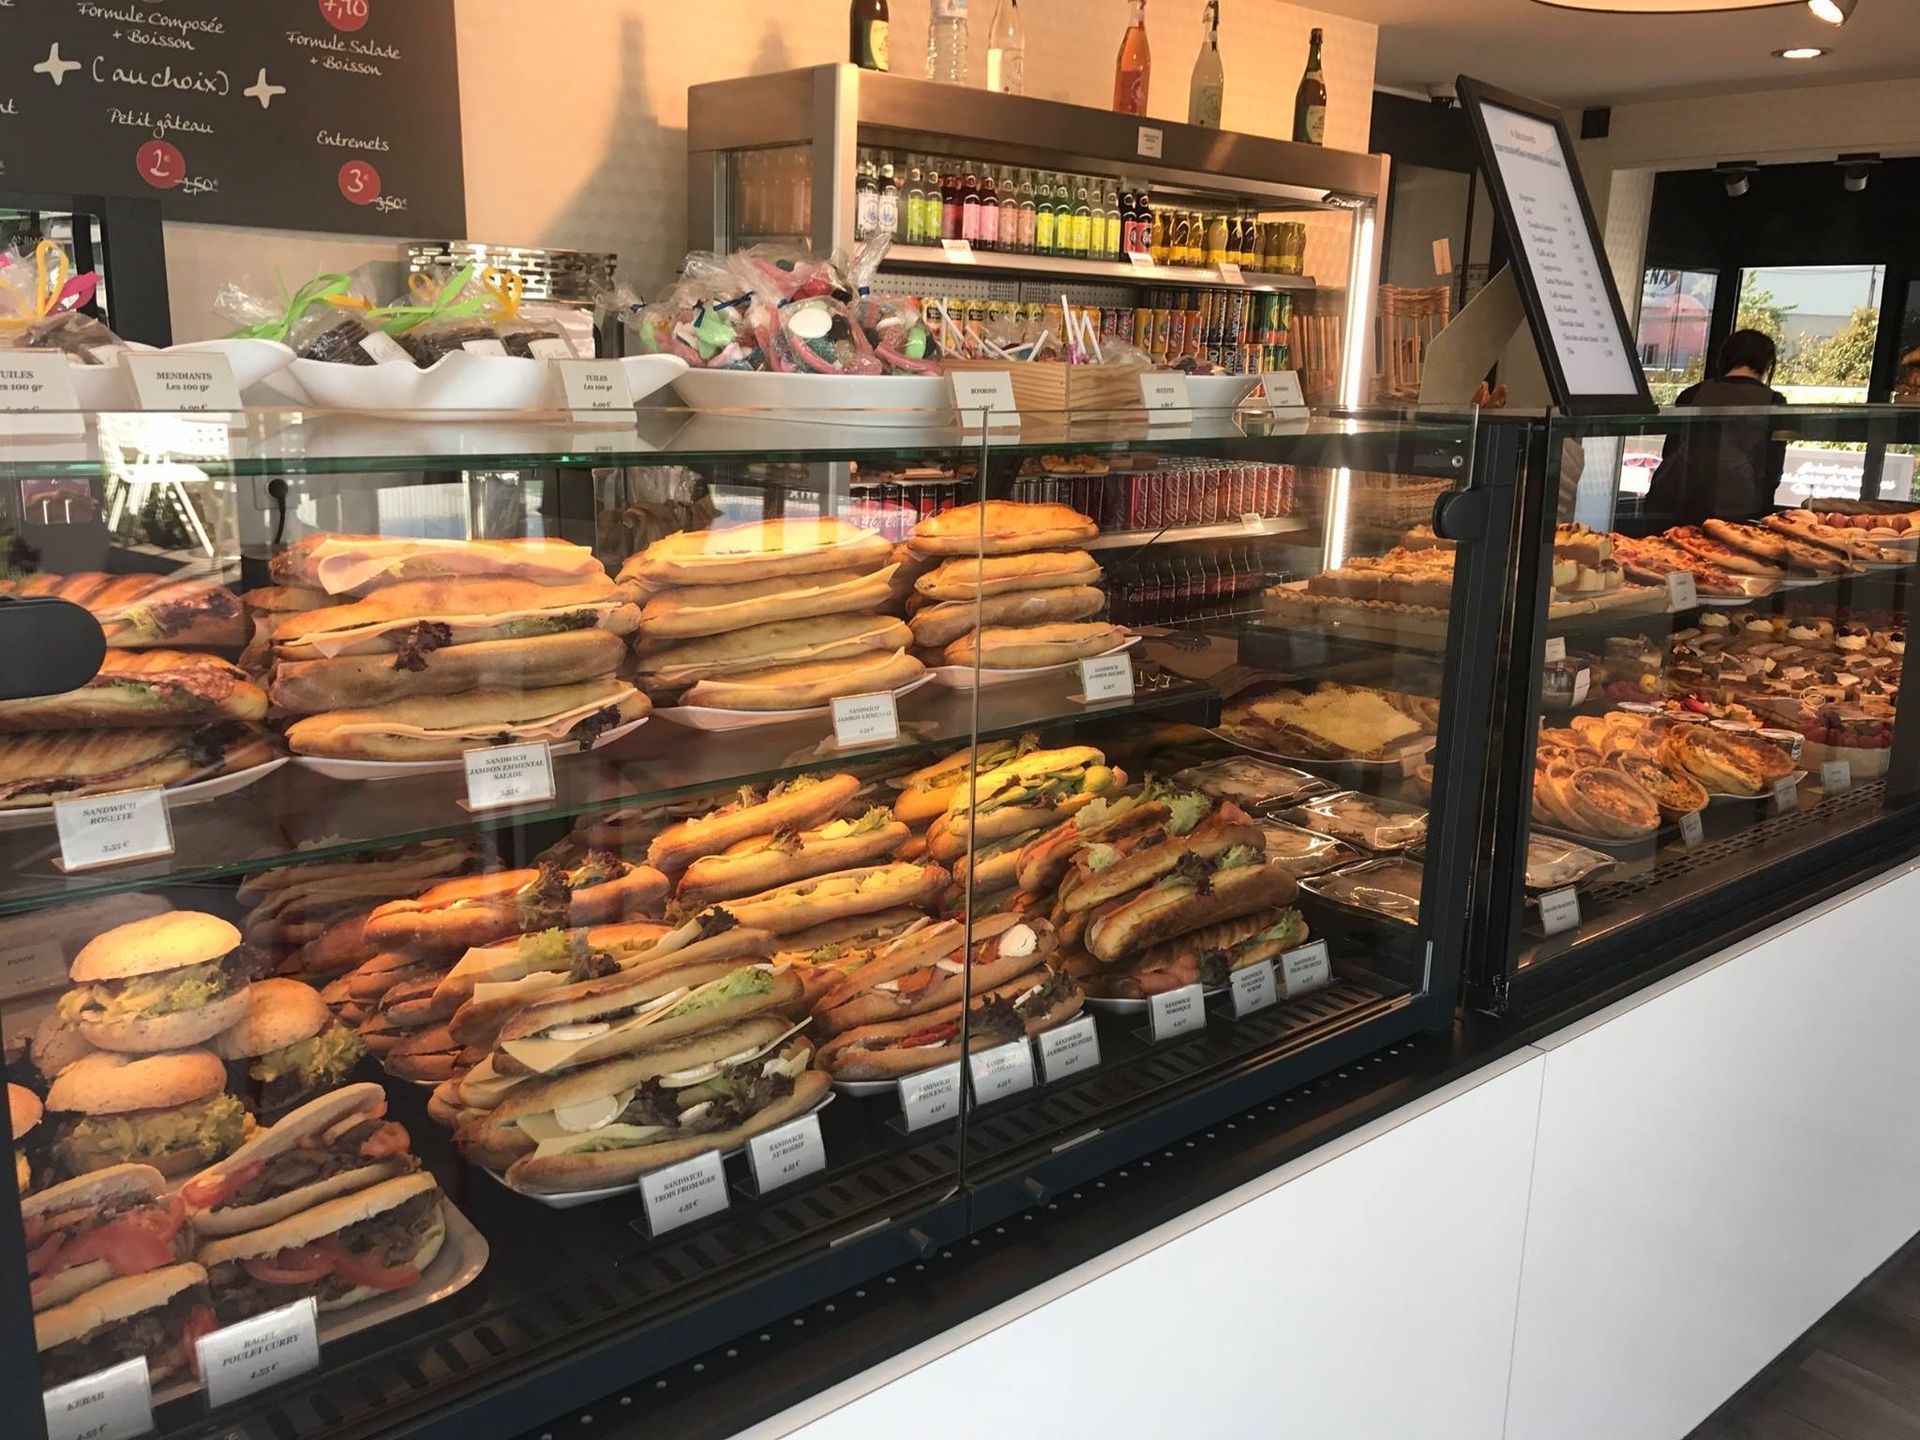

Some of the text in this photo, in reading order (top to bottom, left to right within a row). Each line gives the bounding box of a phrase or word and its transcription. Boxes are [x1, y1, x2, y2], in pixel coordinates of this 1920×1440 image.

[76, 2, 226, 36] Formule Composée
[127, 28, 196, 51] Boisson
[286, 31, 401, 60] Formule Salade
[322, 55, 383, 76] Boisson
[106, 107, 215, 140] Petit gâteau
[316, 129, 390, 152] Entremets
[0, 370, 34, 380] UILES
[156, 371, 213, 381] MENDIANTS
[11, 383, 29, 391] 100
[31, 384, 44, 393] gr
[166, 382, 181, 391] Les
[200, 385, 210, 393] gr
[470, 760, 545, 776] JAMBON EMMENTAL
[485, 754, 527, 765] SANDWICH
[493, 771, 523, 781] SALADE
[83, 801, 138, 817] SANDWICH
[89, 812, 135, 825] ROSETTE
[768, 1132, 805, 1152] SANDWICH
[654, 1173, 716, 1204] TROIS FROMAGES
[663, 1169, 704, 1191] SANDWICH
[243, 1330, 278, 1349] BAGEL
[221, 1333, 300, 1368] POULET CURRY
[66, 1391, 105, 1412] KEBAB
